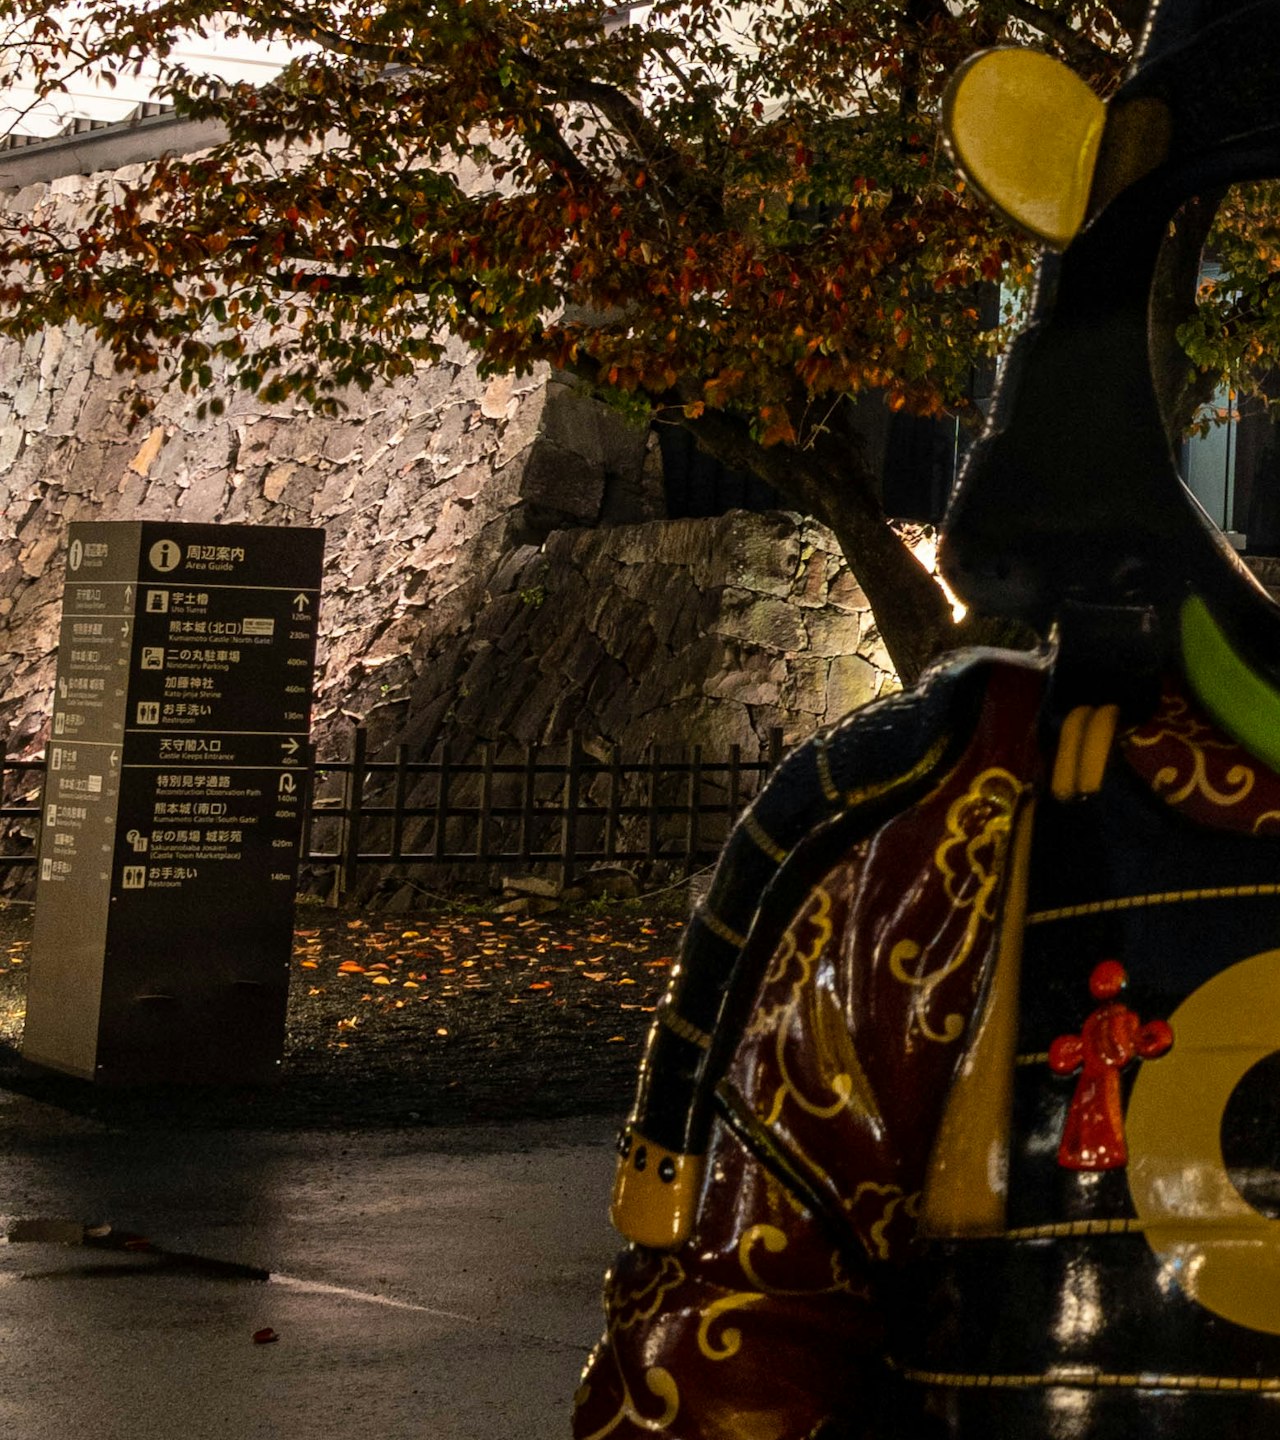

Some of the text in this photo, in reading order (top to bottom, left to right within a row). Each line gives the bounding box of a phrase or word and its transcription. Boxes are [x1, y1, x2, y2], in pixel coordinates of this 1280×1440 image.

[186, 545, 245, 562] 周辺案内
[185, 562, 234, 571] Area Guide
[172, 592, 209, 605] 宇土櫓
[291, 613, 311, 621] 120m
[169, 621, 242, 635] 熊本城(北口)
[168, 635, 207, 643] Kumamoto
[209, 636, 230, 644] Castle
[167, 649, 241, 662] 二の丸駐車場
[166, 662, 230, 671] Ninomaru Parking
[164, 676, 215, 689] 加藤神社
[200, 690, 223, 698] Shrine
[163, 704, 212, 716] お手洗い
[161, 716, 196, 724] Restroom
[159, 739, 222, 752] 天守閣入口
[159, 752, 181, 760] Castle
[204, 753, 235, 761] Entrance
[157, 775, 231, 788] 特別見学通路
[156, 788, 262, 797] Reconstruction Observation Path
[277, 794, 297, 803] 140m
[154, 802, 228, 816] 熊本城(南口)
[275, 810, 296, 818] 400m
[153, 815, 193, 823] Kumamoto
[151, 830, 243, 843] 桜の馬場 城彩苑
[151, 844, 200, 852] Sakuranobaba
[272, 839, 293, 848] 620m
[150, 852, 241, 861] (Castle Town Marketplace)
[148, 867, 198, 880] お手洗い
[270, 873, 291, 881] 140m
[148, 880, 182, 888] Restroom
